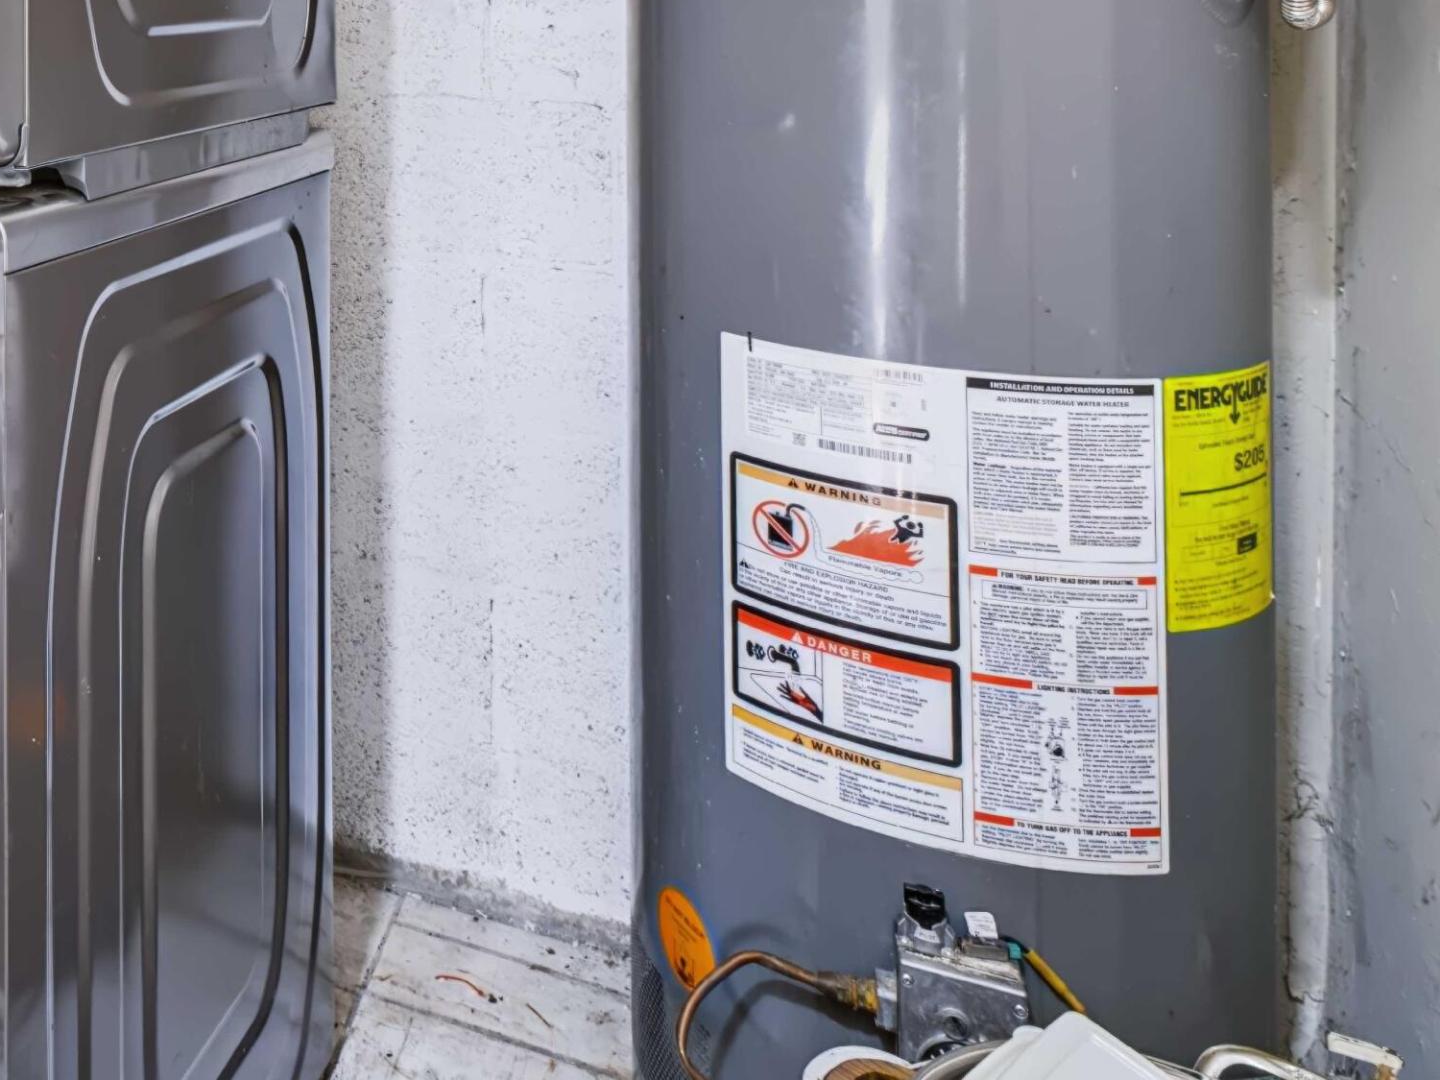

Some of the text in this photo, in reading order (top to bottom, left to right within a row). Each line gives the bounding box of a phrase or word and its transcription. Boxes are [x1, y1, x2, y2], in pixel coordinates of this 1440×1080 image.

[989, 381, 1134, 395] INSTALLATION AND OPERATION DETAILS
[1173, 372, 1268, 414] ENERGYGUIDE
[997, 395, 1040, 406] AUTOMATIC
[1102, 400, 1130, 408] HEATER
[1233, 443, 1265, 471] $205
[804, 481, 882, 506] WARNING
[1000, 571, 1014, 579] FOR
[1034, 574, 1058, 583] SAFETY
[1102, 578, 1134, 586] OPERATING
[806, 636, 873, 664] DANGER
[1037, 684, 1111, 695] LIGHTING INSTRUCTIONS
[810, 738, 883, 771] WARNING
[1027, 823, 1044, 831] TURN
[1096, 829, 1128, 837] APPLIANCE
